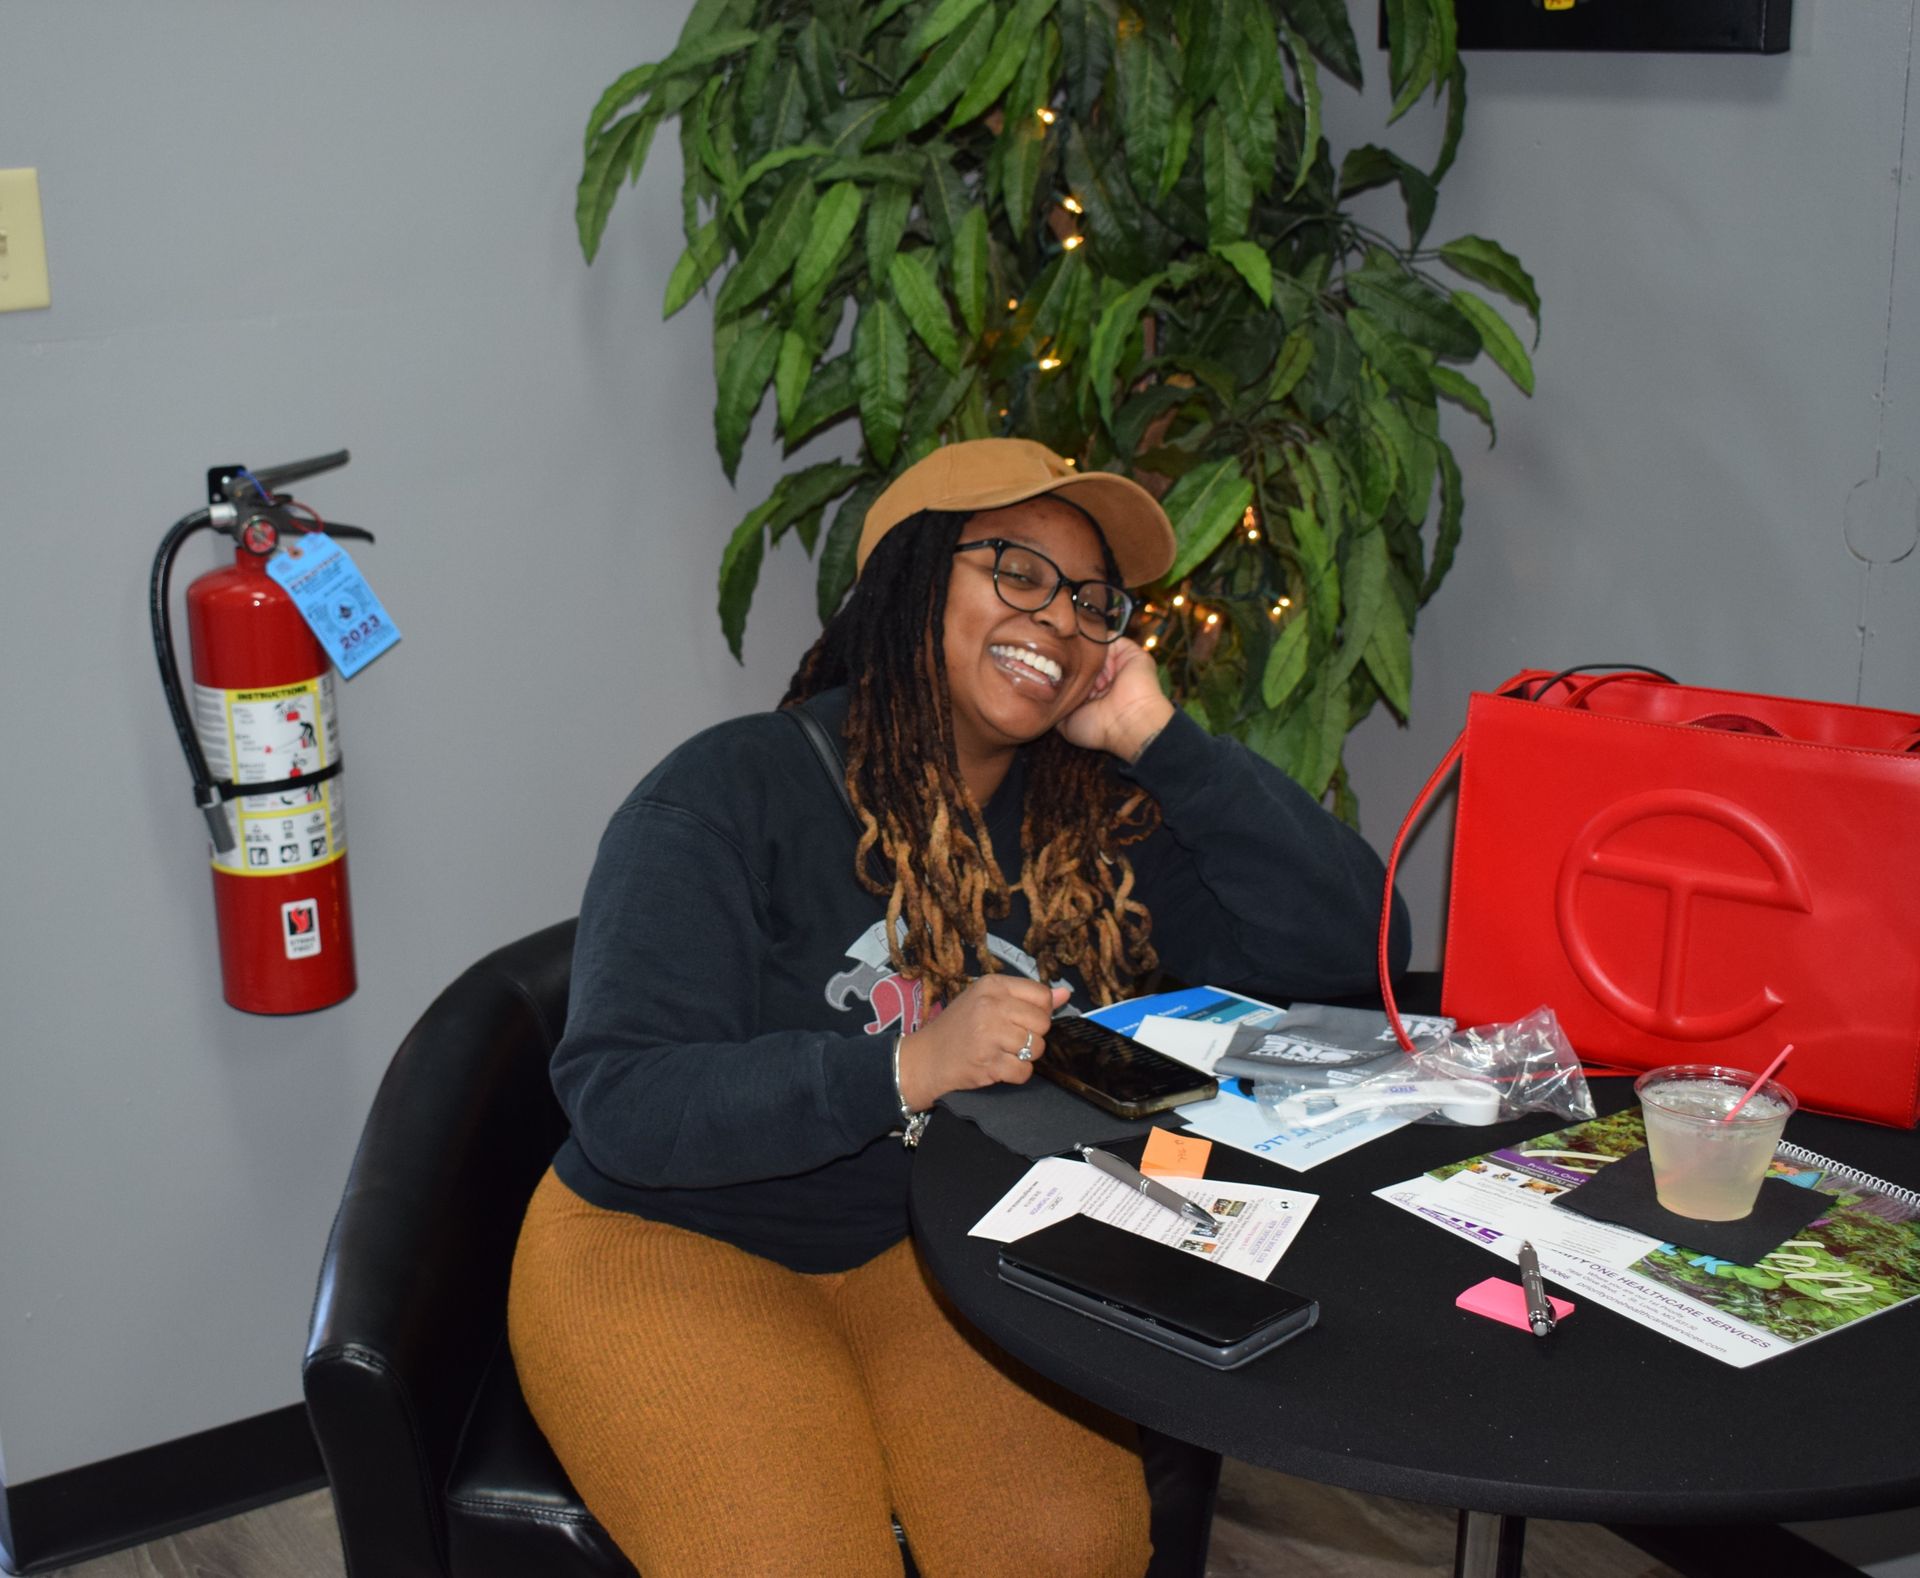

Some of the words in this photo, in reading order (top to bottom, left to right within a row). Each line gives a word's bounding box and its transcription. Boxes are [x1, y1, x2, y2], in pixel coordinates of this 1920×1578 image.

[339, 614, 382, 651] 2023
[237, 685, 308, 701] INSTRUCTIONS
[1252, 1134, 1292, 1153] LLC
[1586, 1263, 1620, 1278] ONE
[1615, 1276, 1706, 1317] HEALTHCARE
[1700, 1315, 1773, 1348] SERVICES
